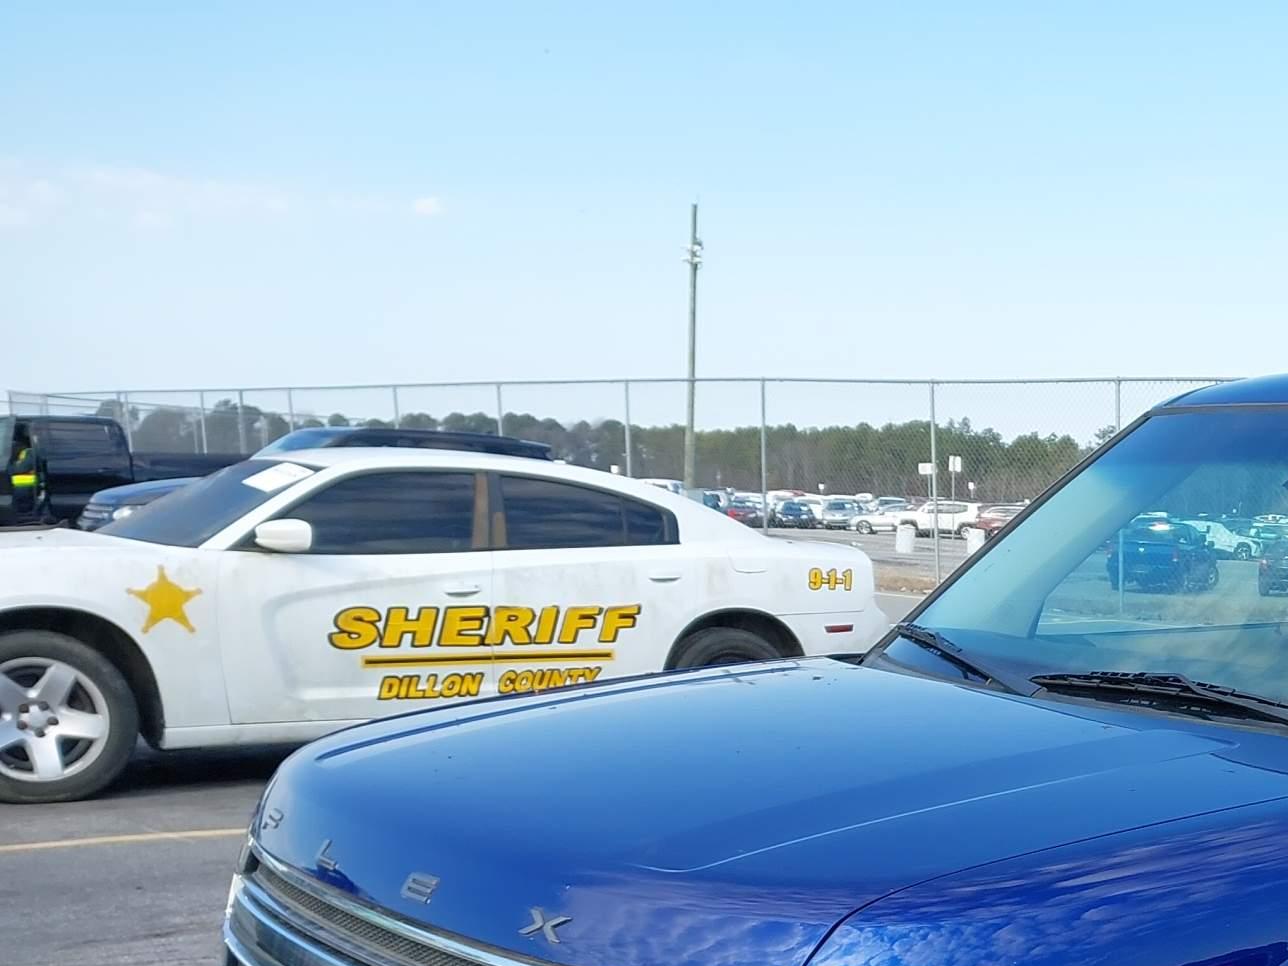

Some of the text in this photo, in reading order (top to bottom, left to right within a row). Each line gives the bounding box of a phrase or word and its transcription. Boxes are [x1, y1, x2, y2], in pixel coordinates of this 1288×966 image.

[808, 568, 853, 591] 9-1-1
[328, 605, 641, 649] SHERIFF
[378, 667, 601, 700] DILLON COUNTY
